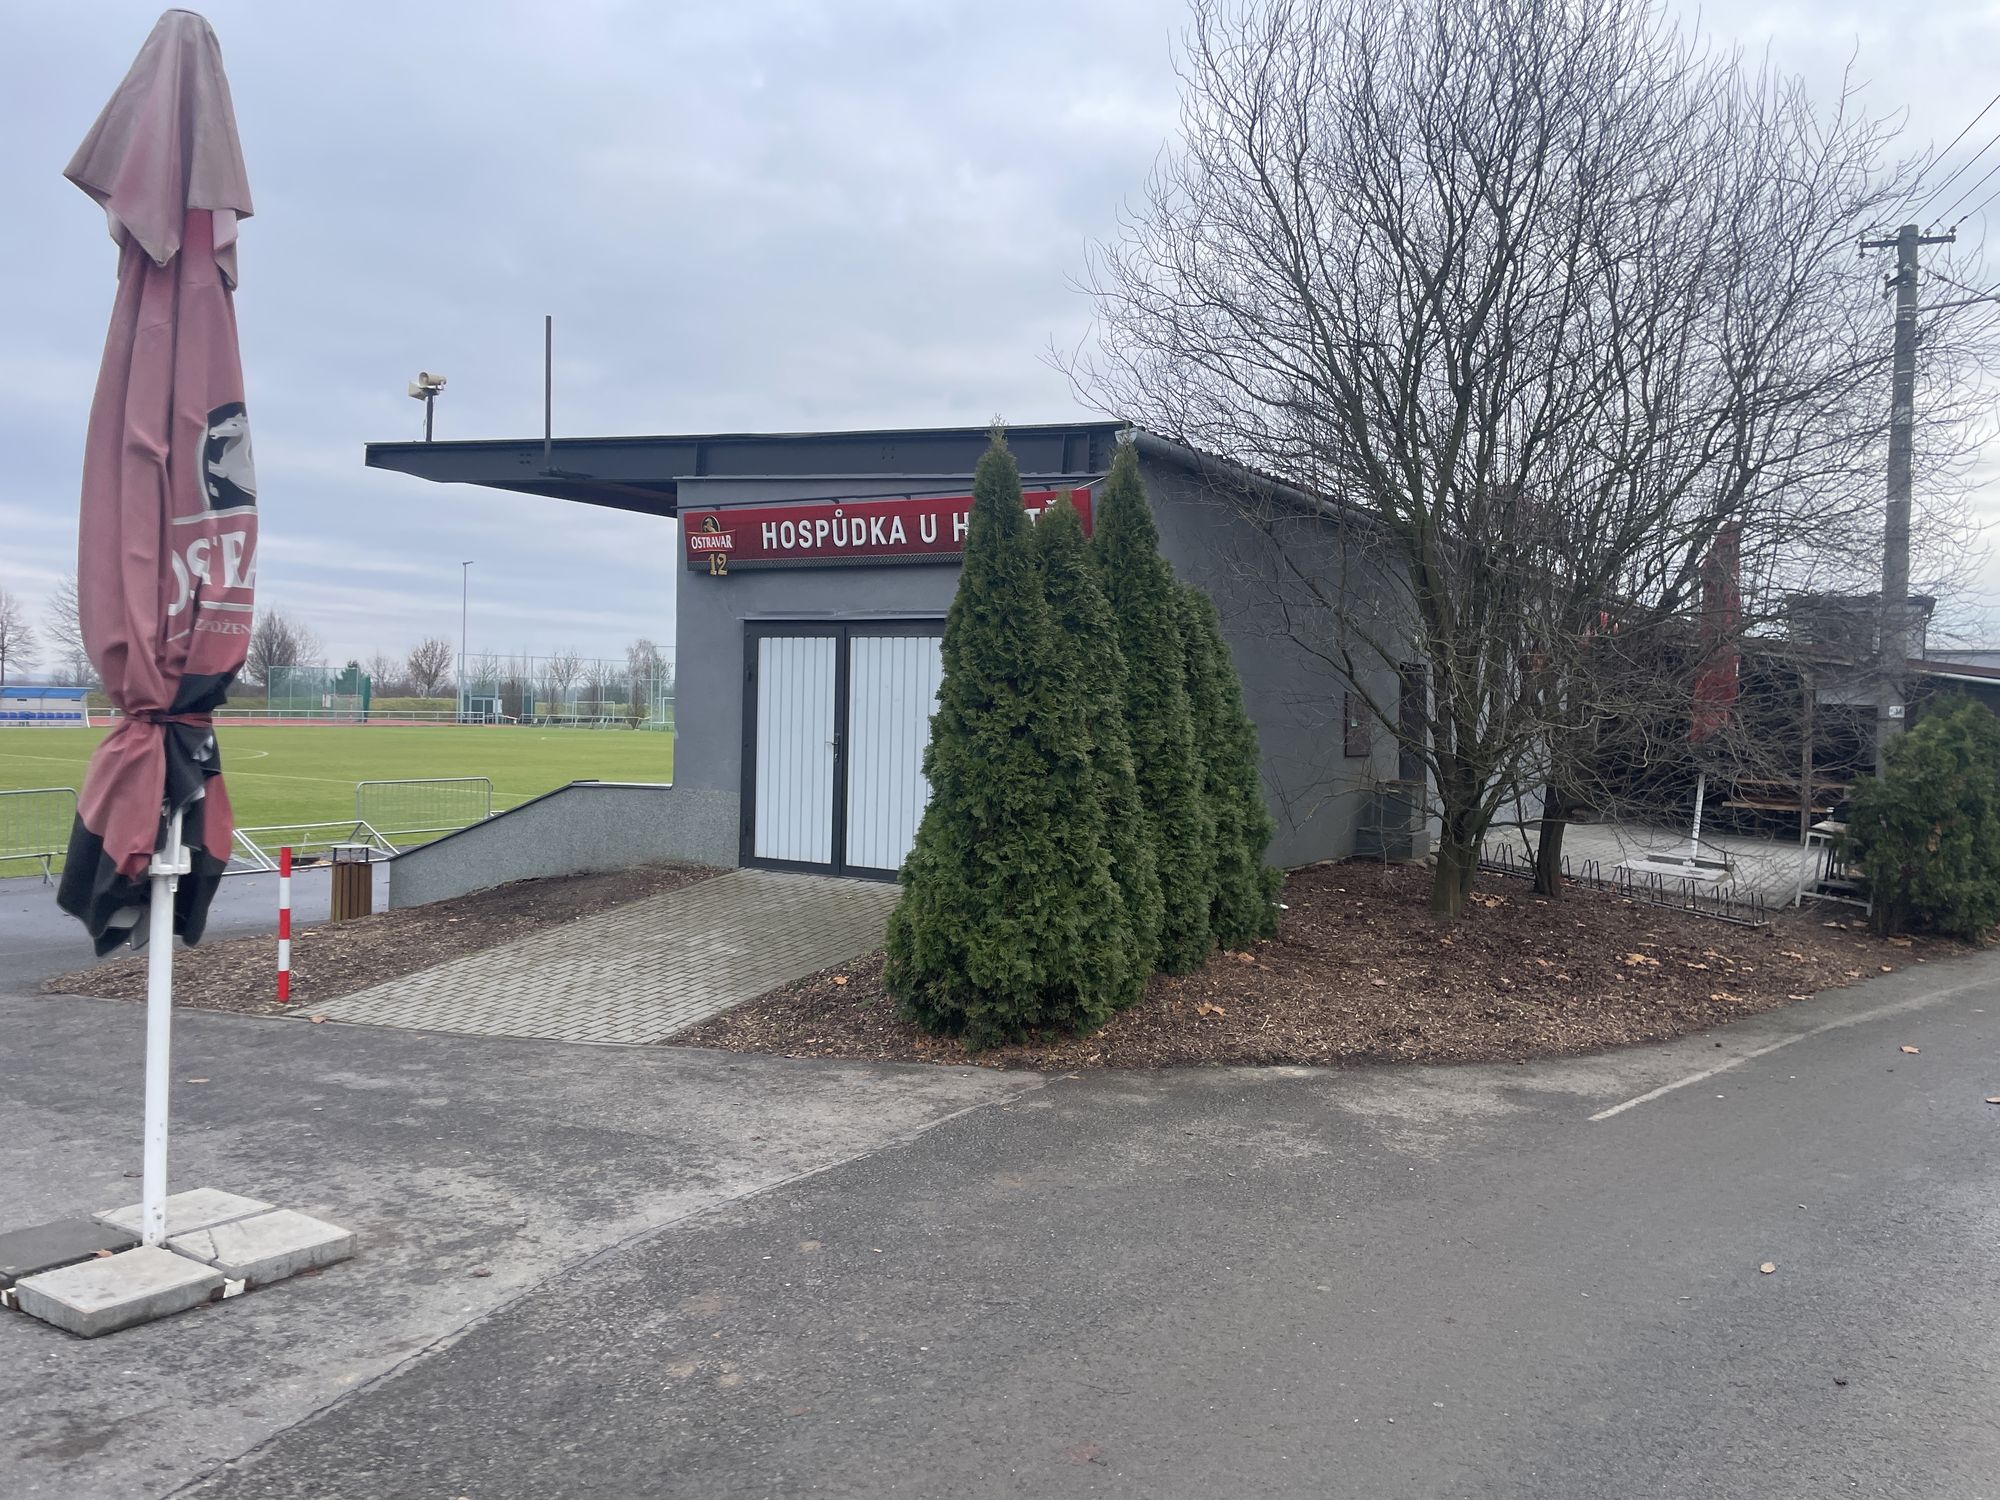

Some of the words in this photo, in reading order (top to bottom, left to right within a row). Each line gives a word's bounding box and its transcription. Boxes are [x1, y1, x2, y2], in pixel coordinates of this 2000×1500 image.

[761, 508, 908, 550] HOSPŮDKA
[919, 513, 938, 544] U
[691, 534, 733, 550] OSTRAVAR
[708, 552, 729, 576] 12
